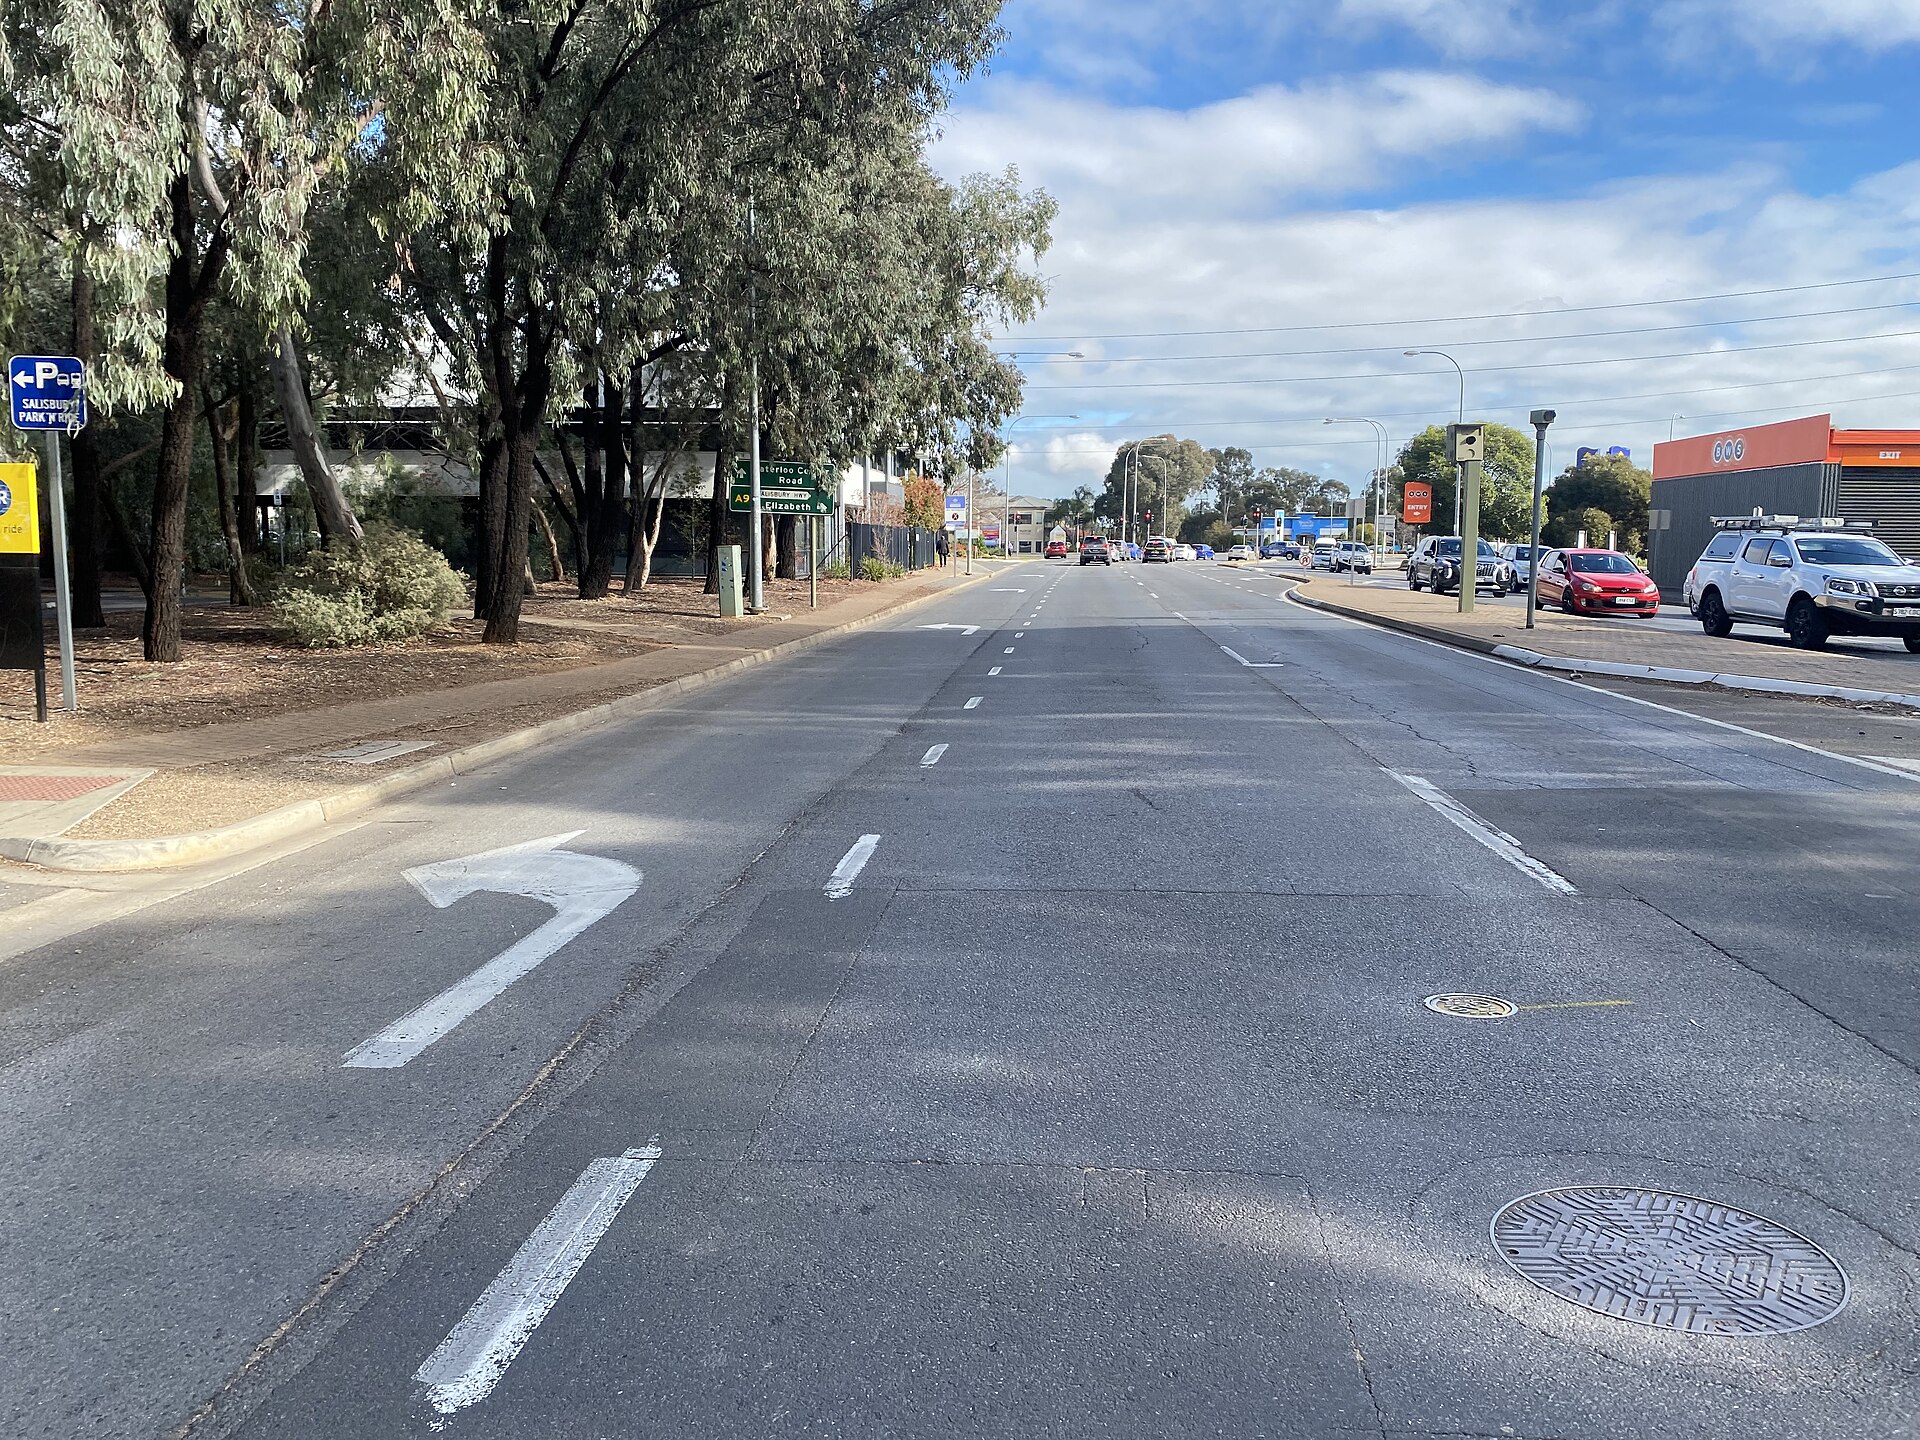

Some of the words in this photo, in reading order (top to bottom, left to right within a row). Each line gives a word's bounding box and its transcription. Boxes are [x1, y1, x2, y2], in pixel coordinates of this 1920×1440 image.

[35, 361, 58, 389] P
[18, 412, 46, 423] PARK
[1879, 451, 1901, 459] EXIT
[760, 466, 794, 474] aterloo
[778, 476, 803, 485] Road
[734, 494, 750, 503] A9
[765, 501, 811, 511] Elizabeth
[3, 524, 23, 534] ride
